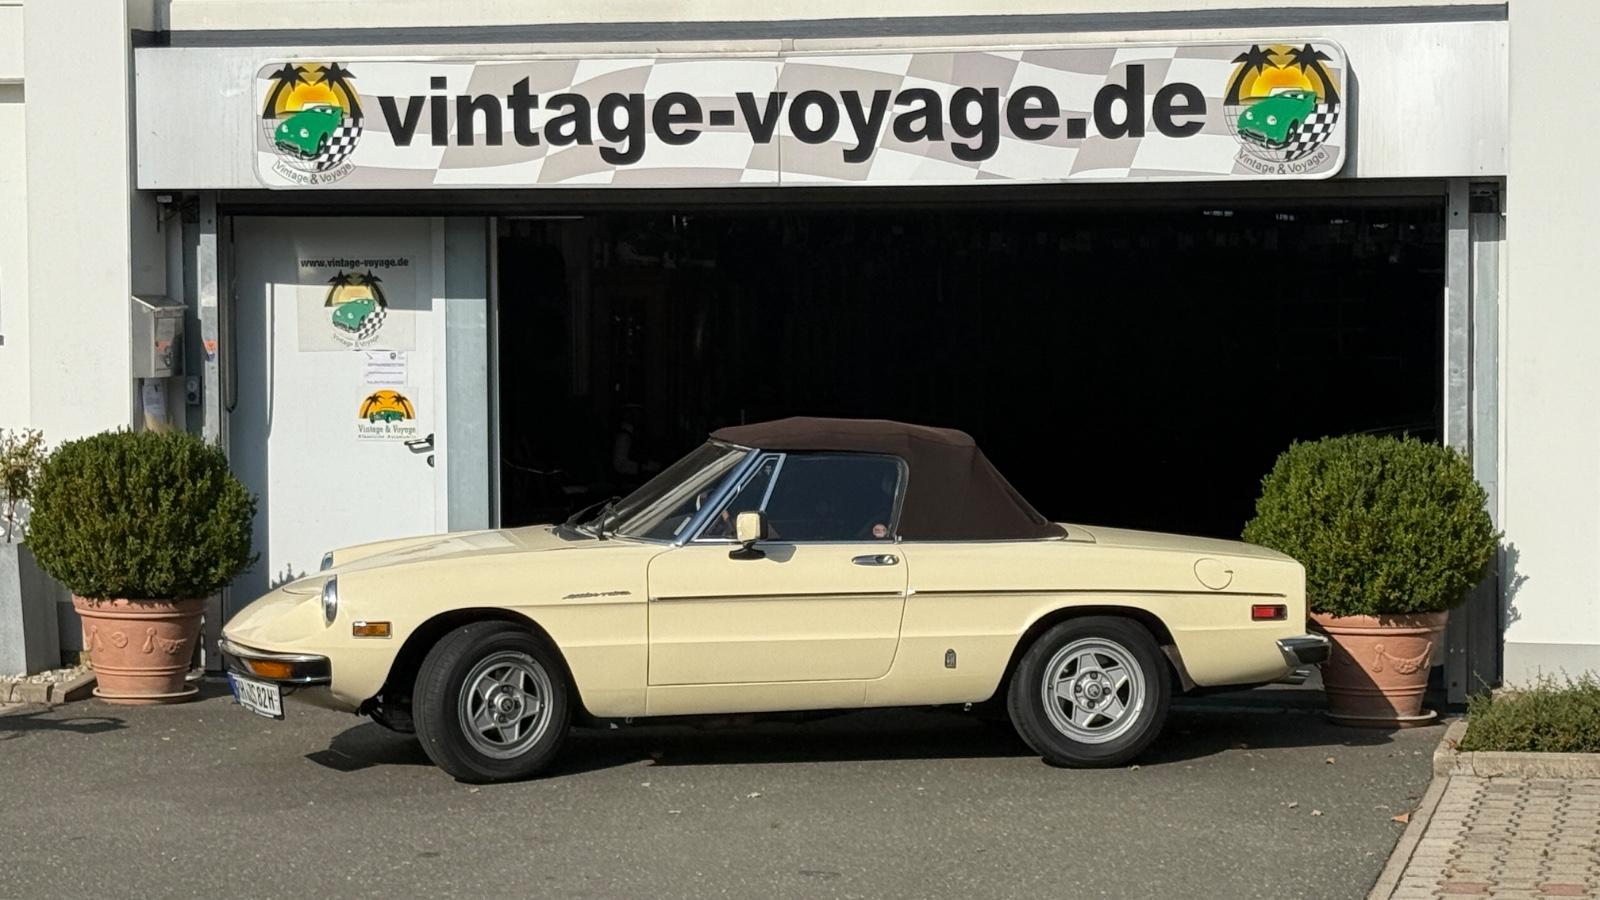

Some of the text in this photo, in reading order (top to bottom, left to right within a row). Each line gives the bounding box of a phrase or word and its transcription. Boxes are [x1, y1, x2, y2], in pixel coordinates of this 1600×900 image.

[378, 64, 1207, 165] vintage-voyage.de
[275, 161, 352, 185] Vintage & Voyage
[1238, 150, 1325, 175] Vintage & Voyage
[300, 257, 409, 269] www.vintage-voyage.de
